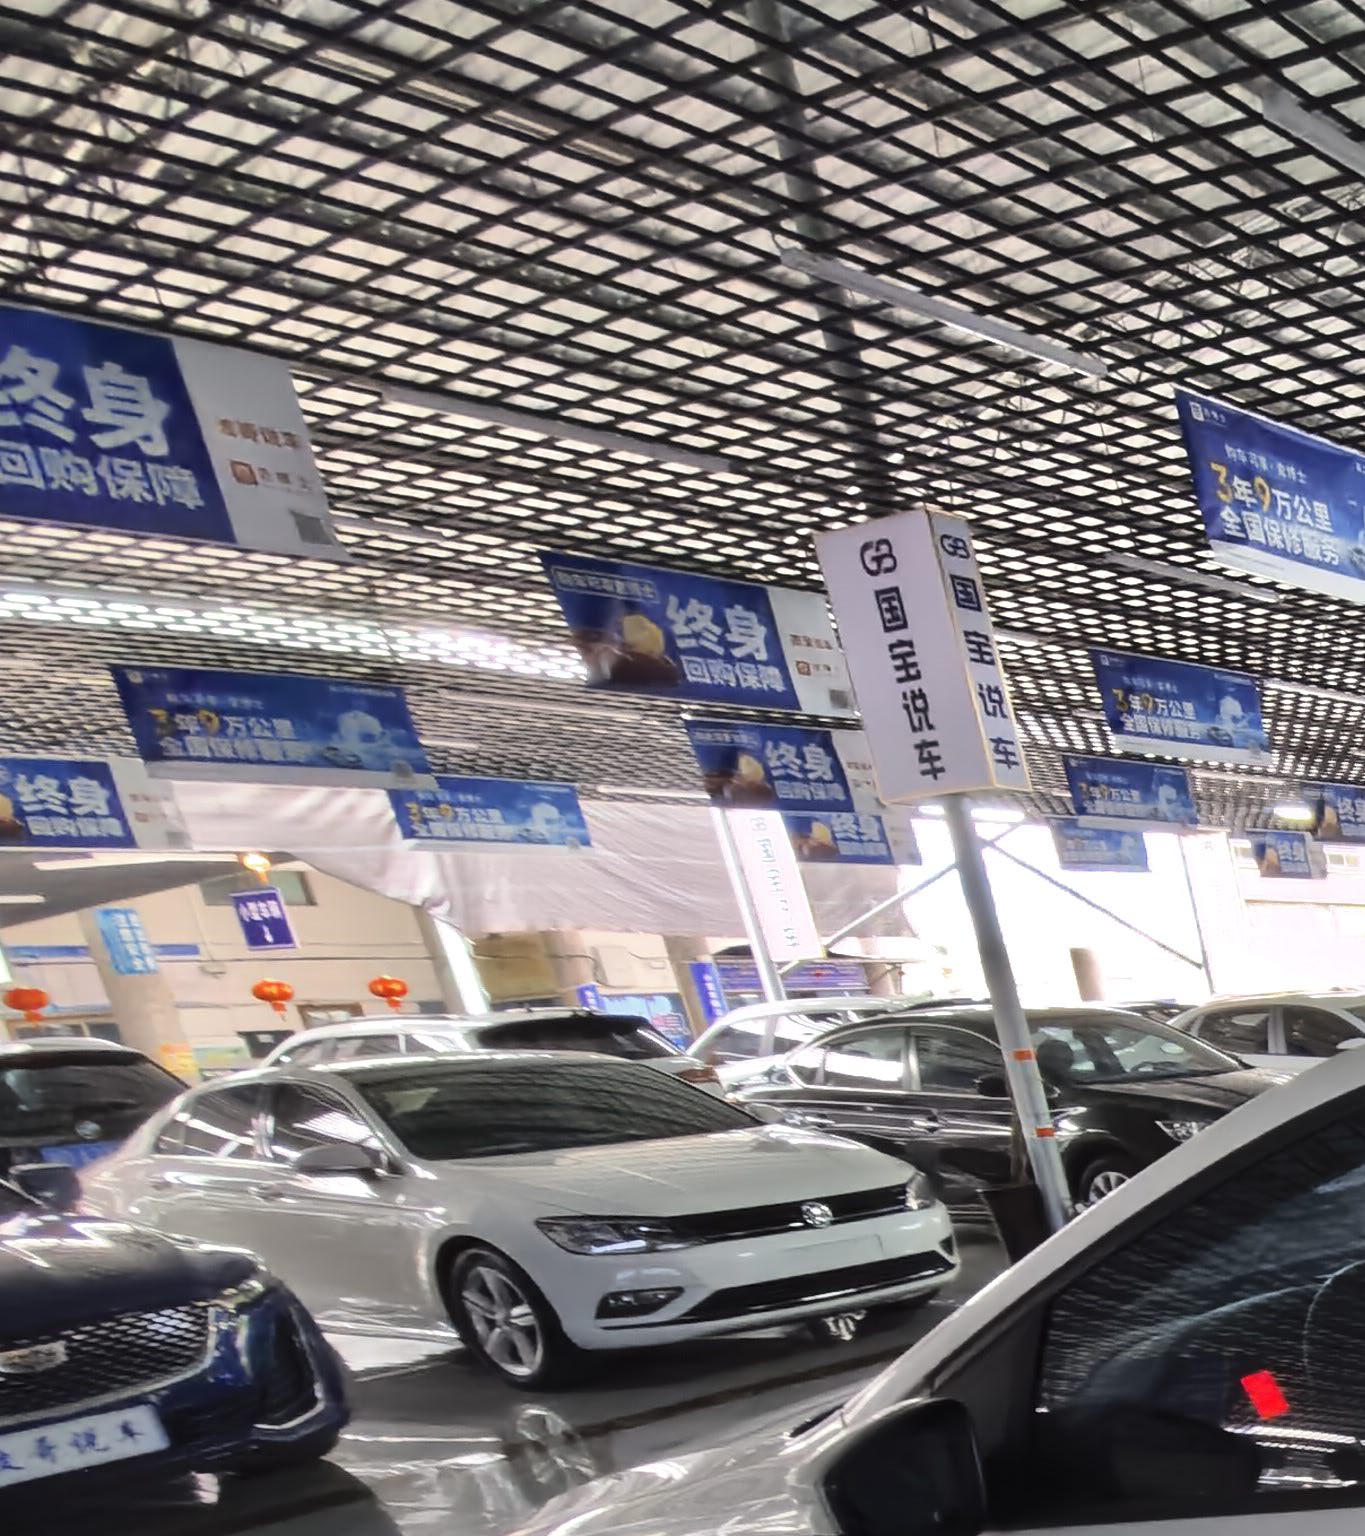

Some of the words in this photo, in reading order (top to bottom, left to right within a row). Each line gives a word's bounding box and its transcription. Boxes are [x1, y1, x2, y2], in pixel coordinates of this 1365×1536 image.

[0, 344, 170, 456] 终身
[0, 438, 204, 511] 回购保障
[1210, 461, 1334, 533] 3年9万公里
[1220, 506, 1340, 566] 全国保修服务
[666, 595, 767, 661] 终身
[679, 655, 786, 692] 回购保障
[874, 586, 945, 780] 国宝说车
[950, 574, 1020, 769] 国宝说车
[14, 773, 110, 816] 终身
[765, 740, 833, 781] 终身
